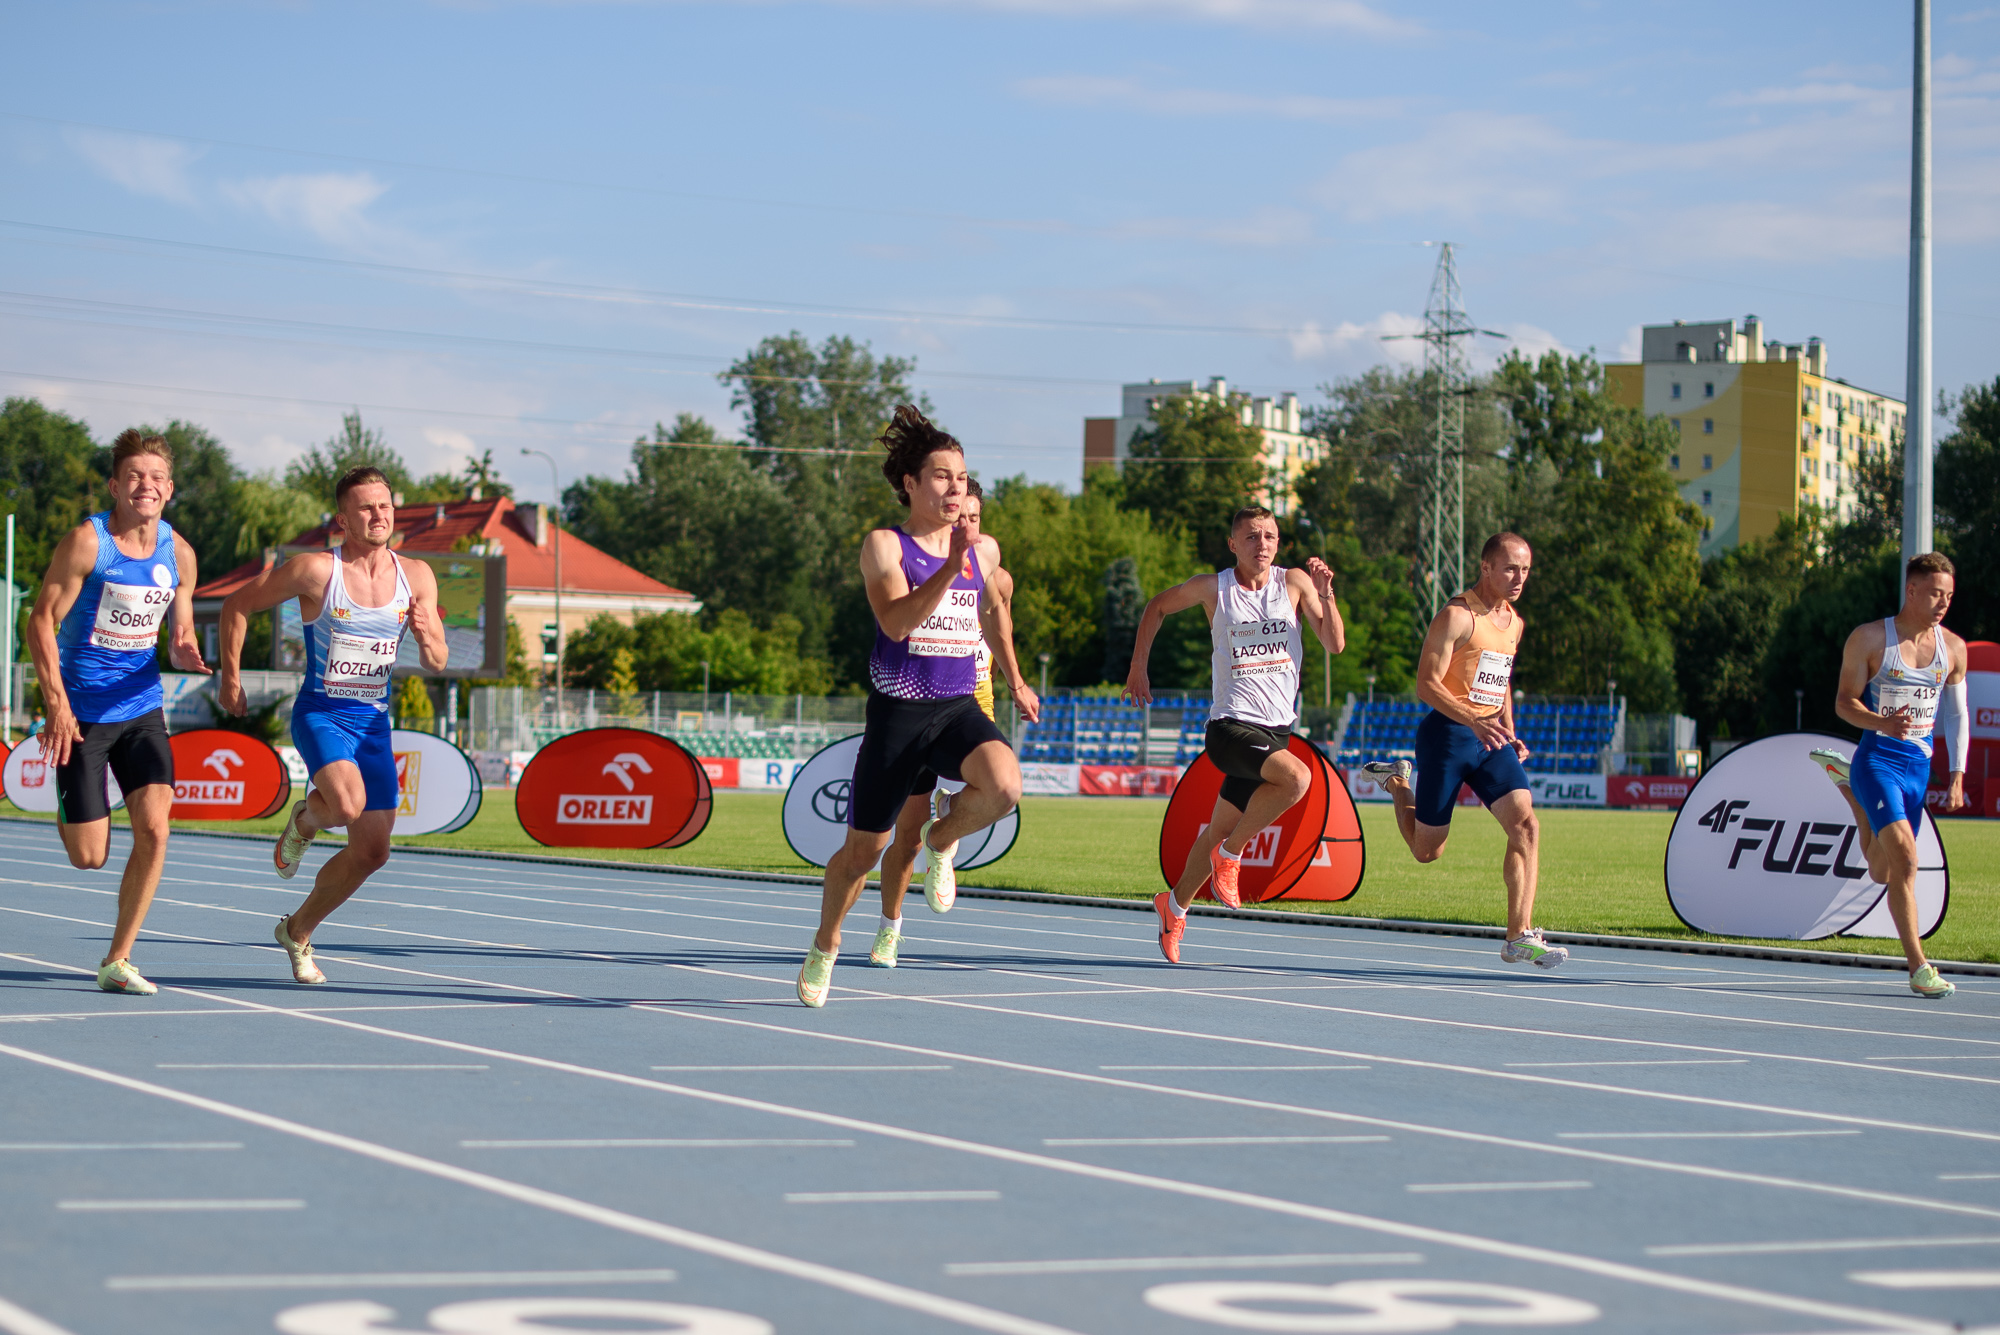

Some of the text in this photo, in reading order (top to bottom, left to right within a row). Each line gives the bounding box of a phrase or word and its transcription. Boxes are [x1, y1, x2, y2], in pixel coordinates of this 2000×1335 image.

[144, 590, 171, 604] 624
[951, 592, 975, 607] 560
[109, 610, 155, 627] SOBÓL
[916, 614, 977, 631] OGACZYŃSKI
[1262, 621, 1287, 635] 612
[97, 636, 147, 648] RADOM 2022
[370, 641, 396, 655] 415
[914, 644, 968, 655] RADOM 2022
[1232, 640, 1288, 659] ŁAZOWY
[328, 659, 393, 678] KOZELAN
[1237, 665, 1282, 677] RADOM 2022
[327, 687, 378, 698] RADOM 2022
[1913, 688, 1936, 700] 419
[175, 785, 239, 800] ORLEN
[1545, 783, 1598, 800] FUEL
[563, 800, 647, 820] ORLEN
[1698, 799, 1868, 880] 4F FUEL
